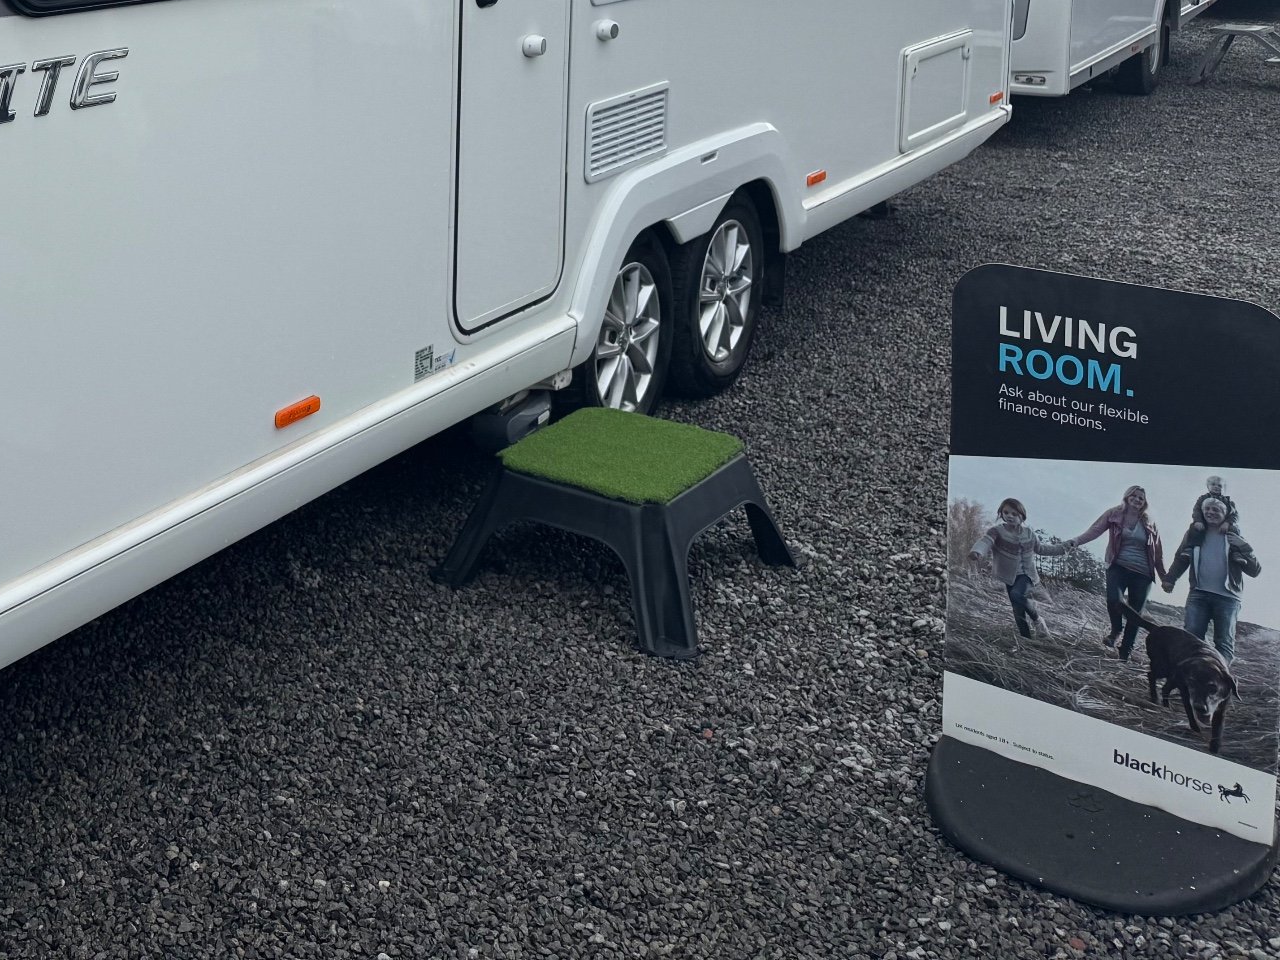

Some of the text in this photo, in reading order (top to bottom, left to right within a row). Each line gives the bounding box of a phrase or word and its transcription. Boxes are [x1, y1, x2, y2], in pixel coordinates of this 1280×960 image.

[999, 305, 1138, 360] LIVING
[998, 342, 1135, 398] ROOM.
[998, 383, 1149, 425] Ask about our flexible
[998, 397, 1107, 432] finance options.
[1113, 749, 1213, 795] blackhorse
